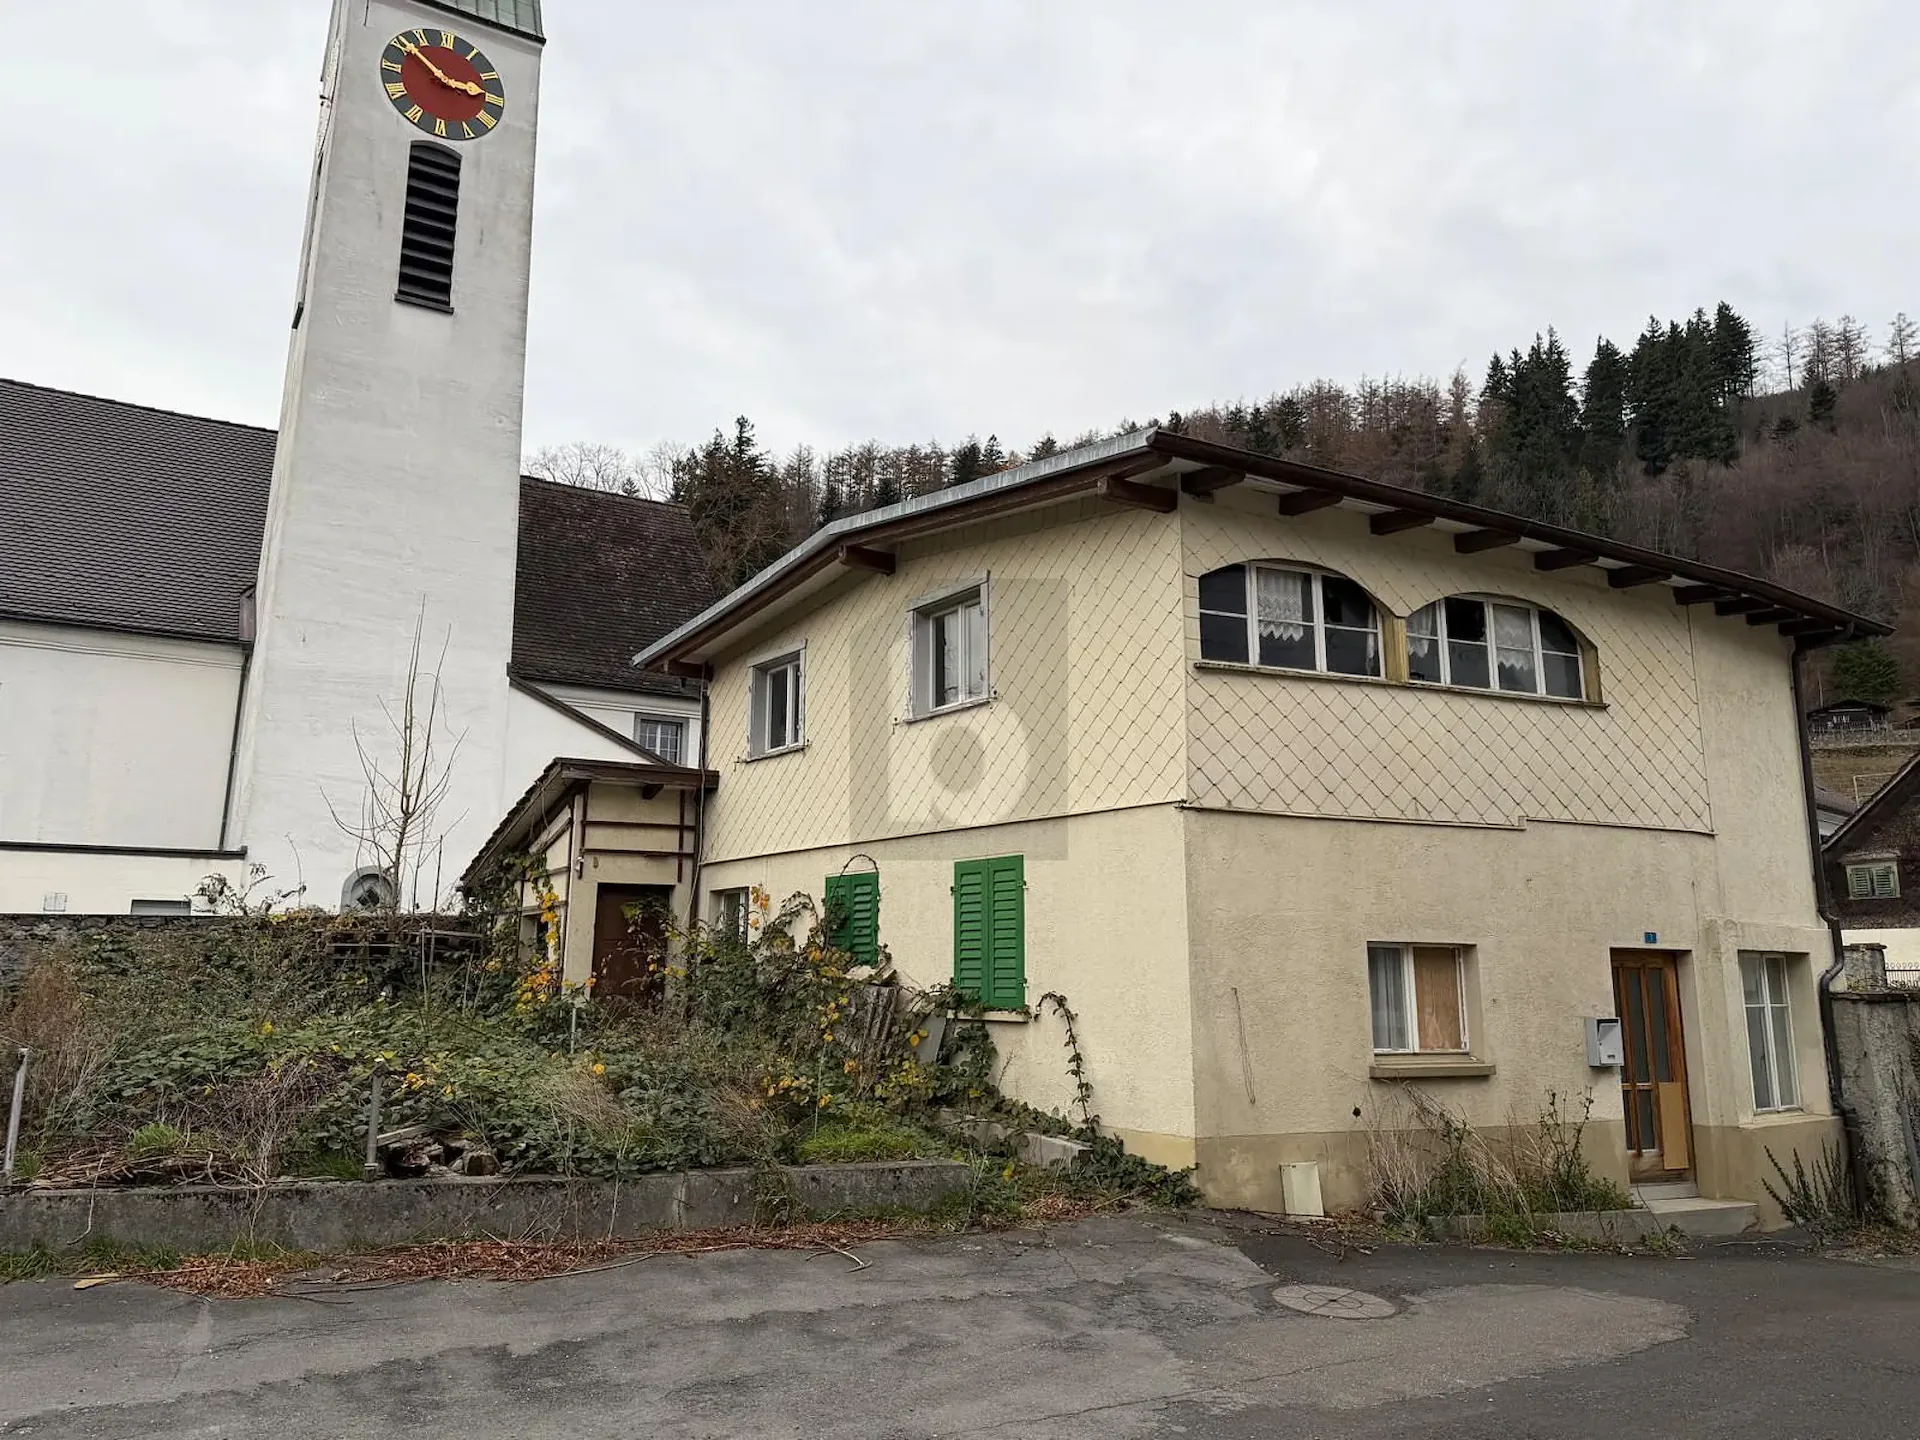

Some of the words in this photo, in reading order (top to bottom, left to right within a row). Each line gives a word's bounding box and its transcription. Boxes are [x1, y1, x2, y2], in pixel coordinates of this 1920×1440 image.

[440, 31, 455, 50] XII
[465, 47, 479, 61] I
[480, 71, 499, 80] II
[384, 82, 408, 100] VIII
[485, 91, 504, 108] III
[403, 104, 423, 123] VII
[434, 118, 447, 136] VI
[461, 120, 475, 138] V
